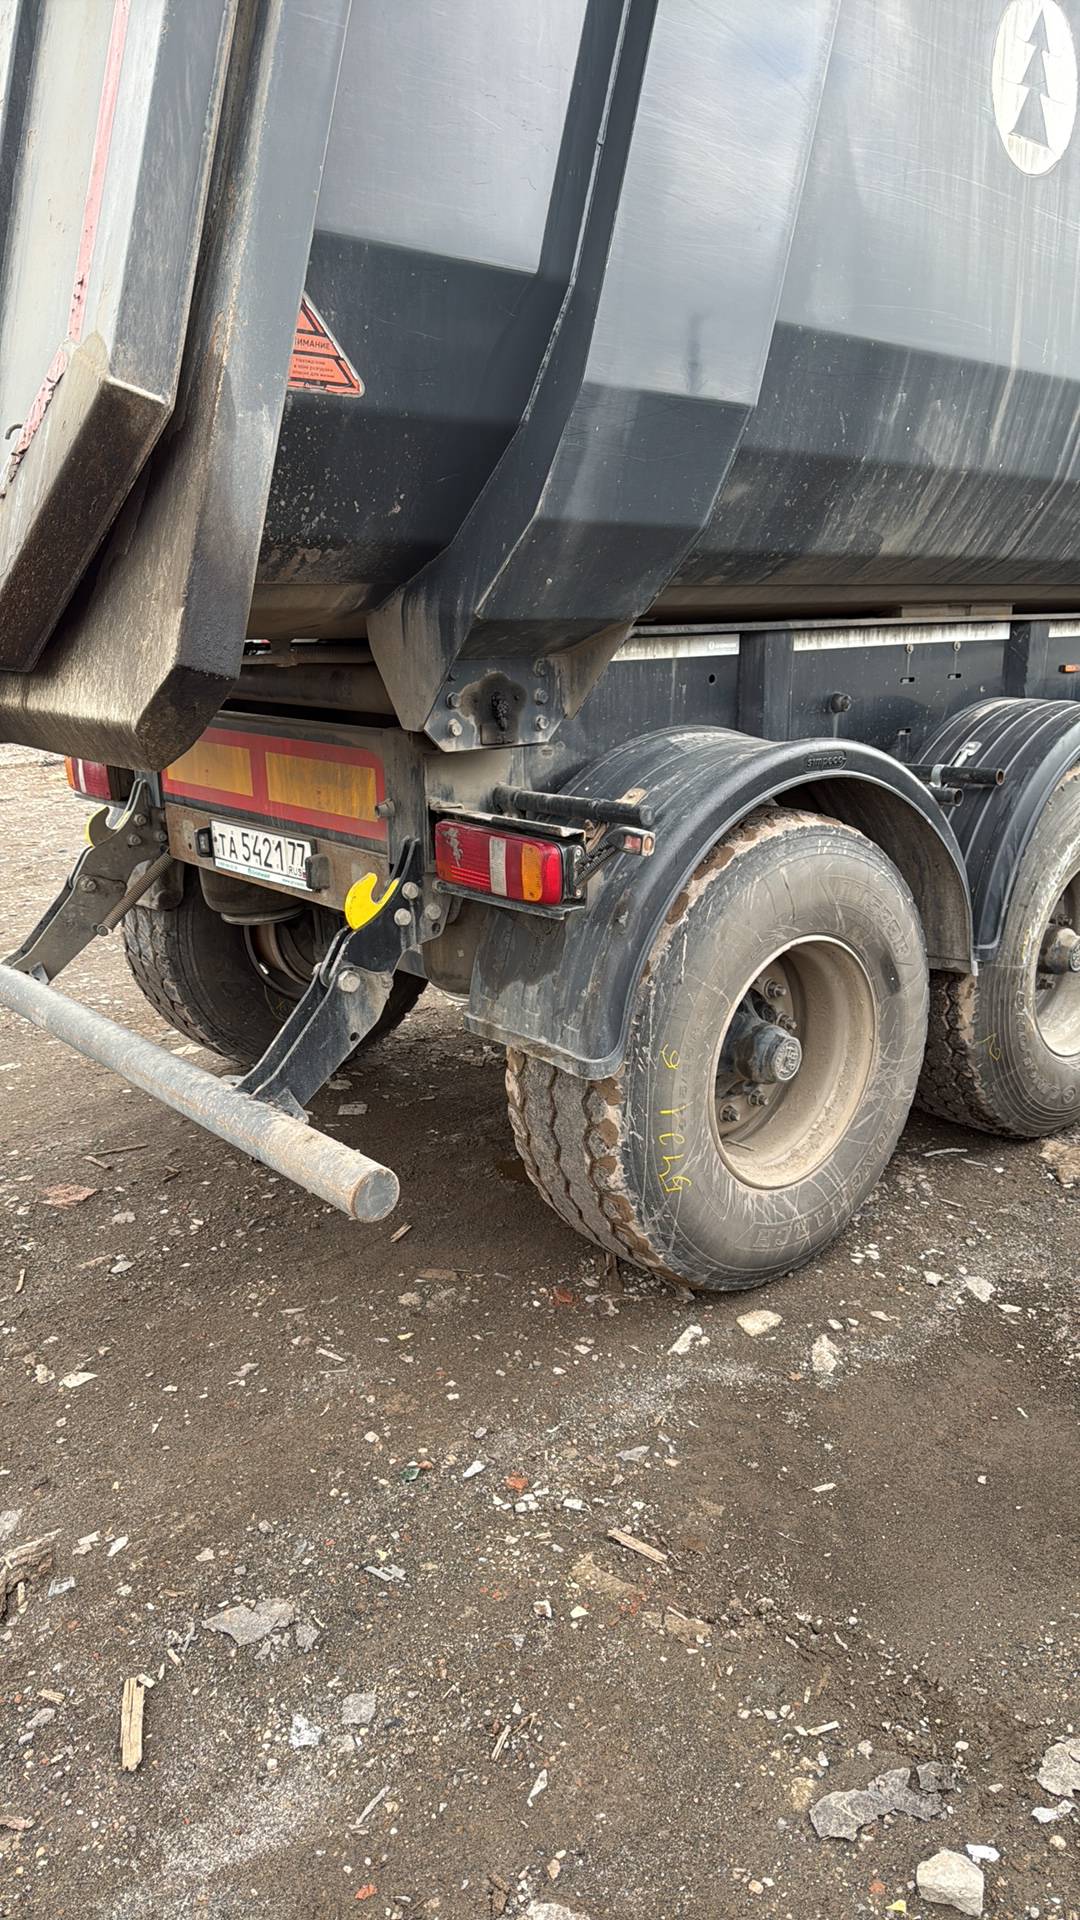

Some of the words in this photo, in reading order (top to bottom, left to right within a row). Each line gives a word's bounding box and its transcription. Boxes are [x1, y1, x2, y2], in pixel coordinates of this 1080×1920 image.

[295, 336, 330, 350] ИМАНИЕ
[287, 841, 305, 867] 77
[288, 865, 304, 877] RUS
